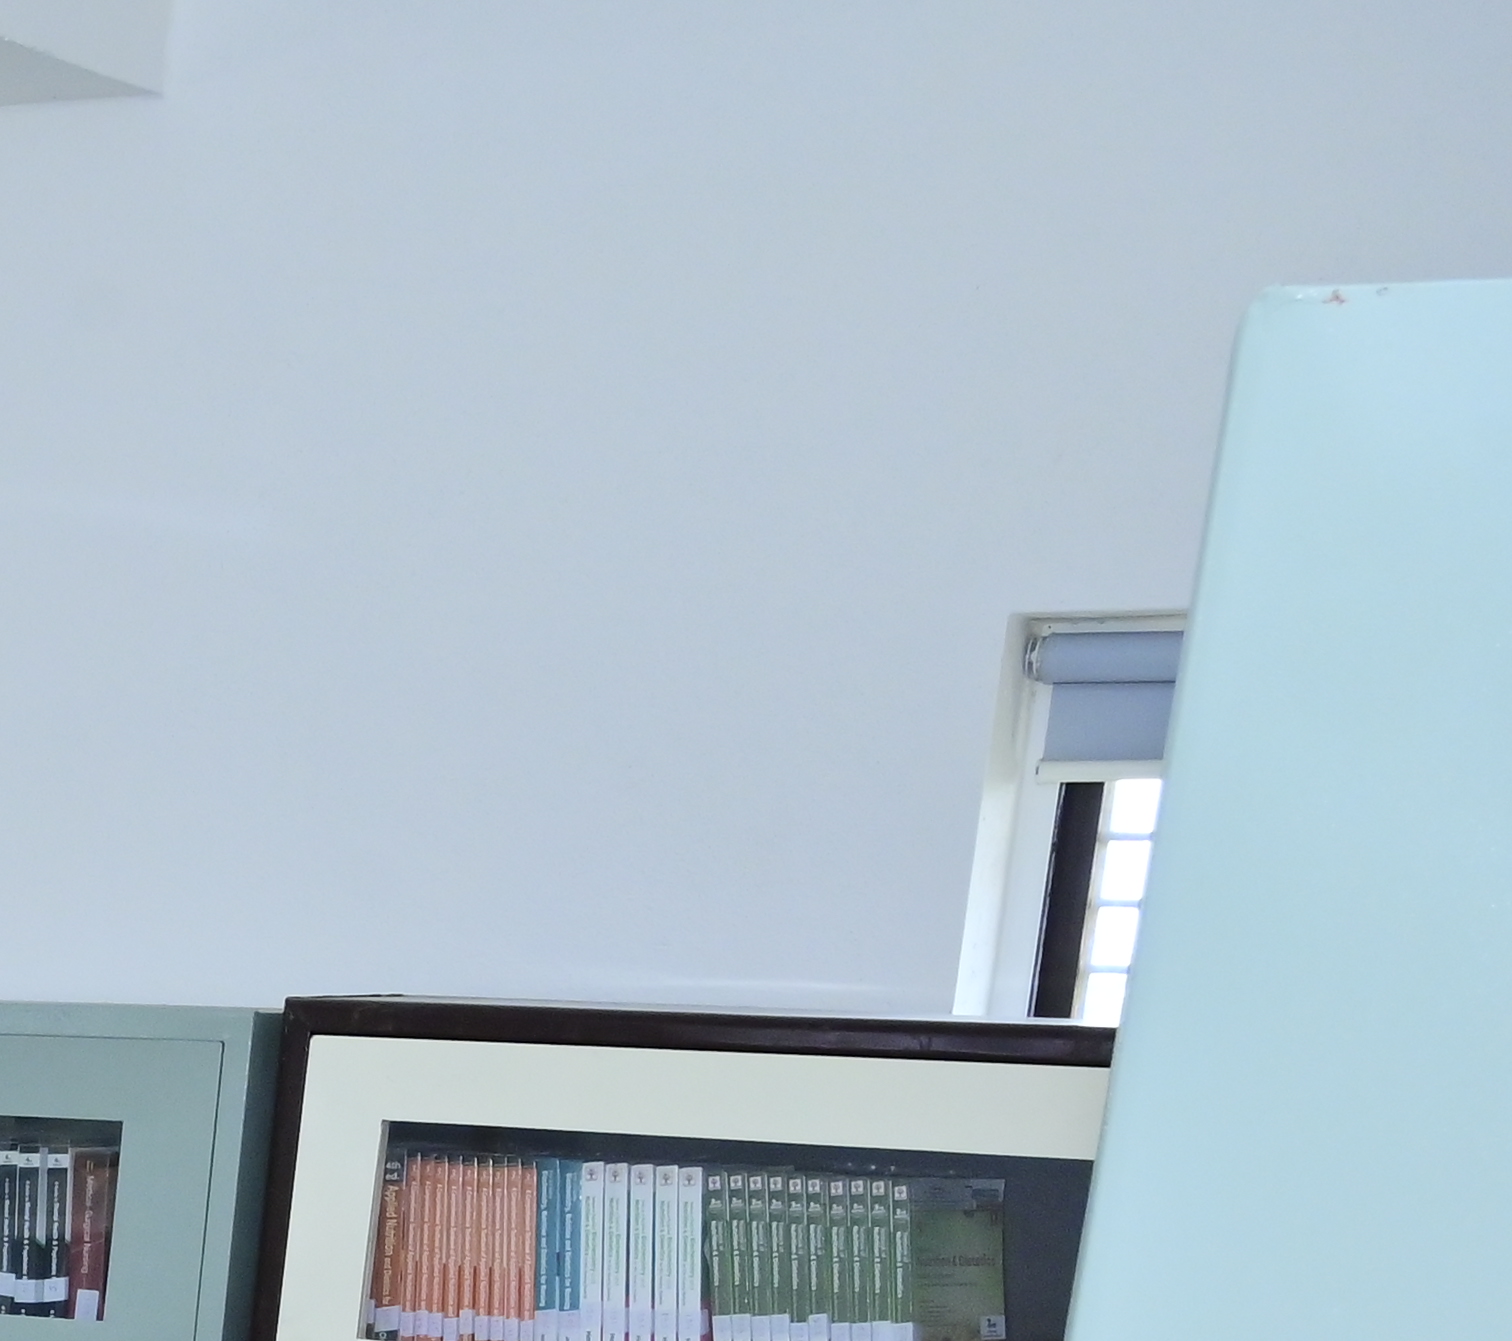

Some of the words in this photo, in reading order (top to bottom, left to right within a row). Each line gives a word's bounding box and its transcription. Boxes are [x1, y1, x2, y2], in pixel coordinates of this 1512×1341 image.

[385, 1185, 397, 1217] Applied
[385, 1219, 397, 1255] Nutrition
[81, 1244, 91, 1273] Nursing
[688, 1238, 696, 1278] Biochemistry
